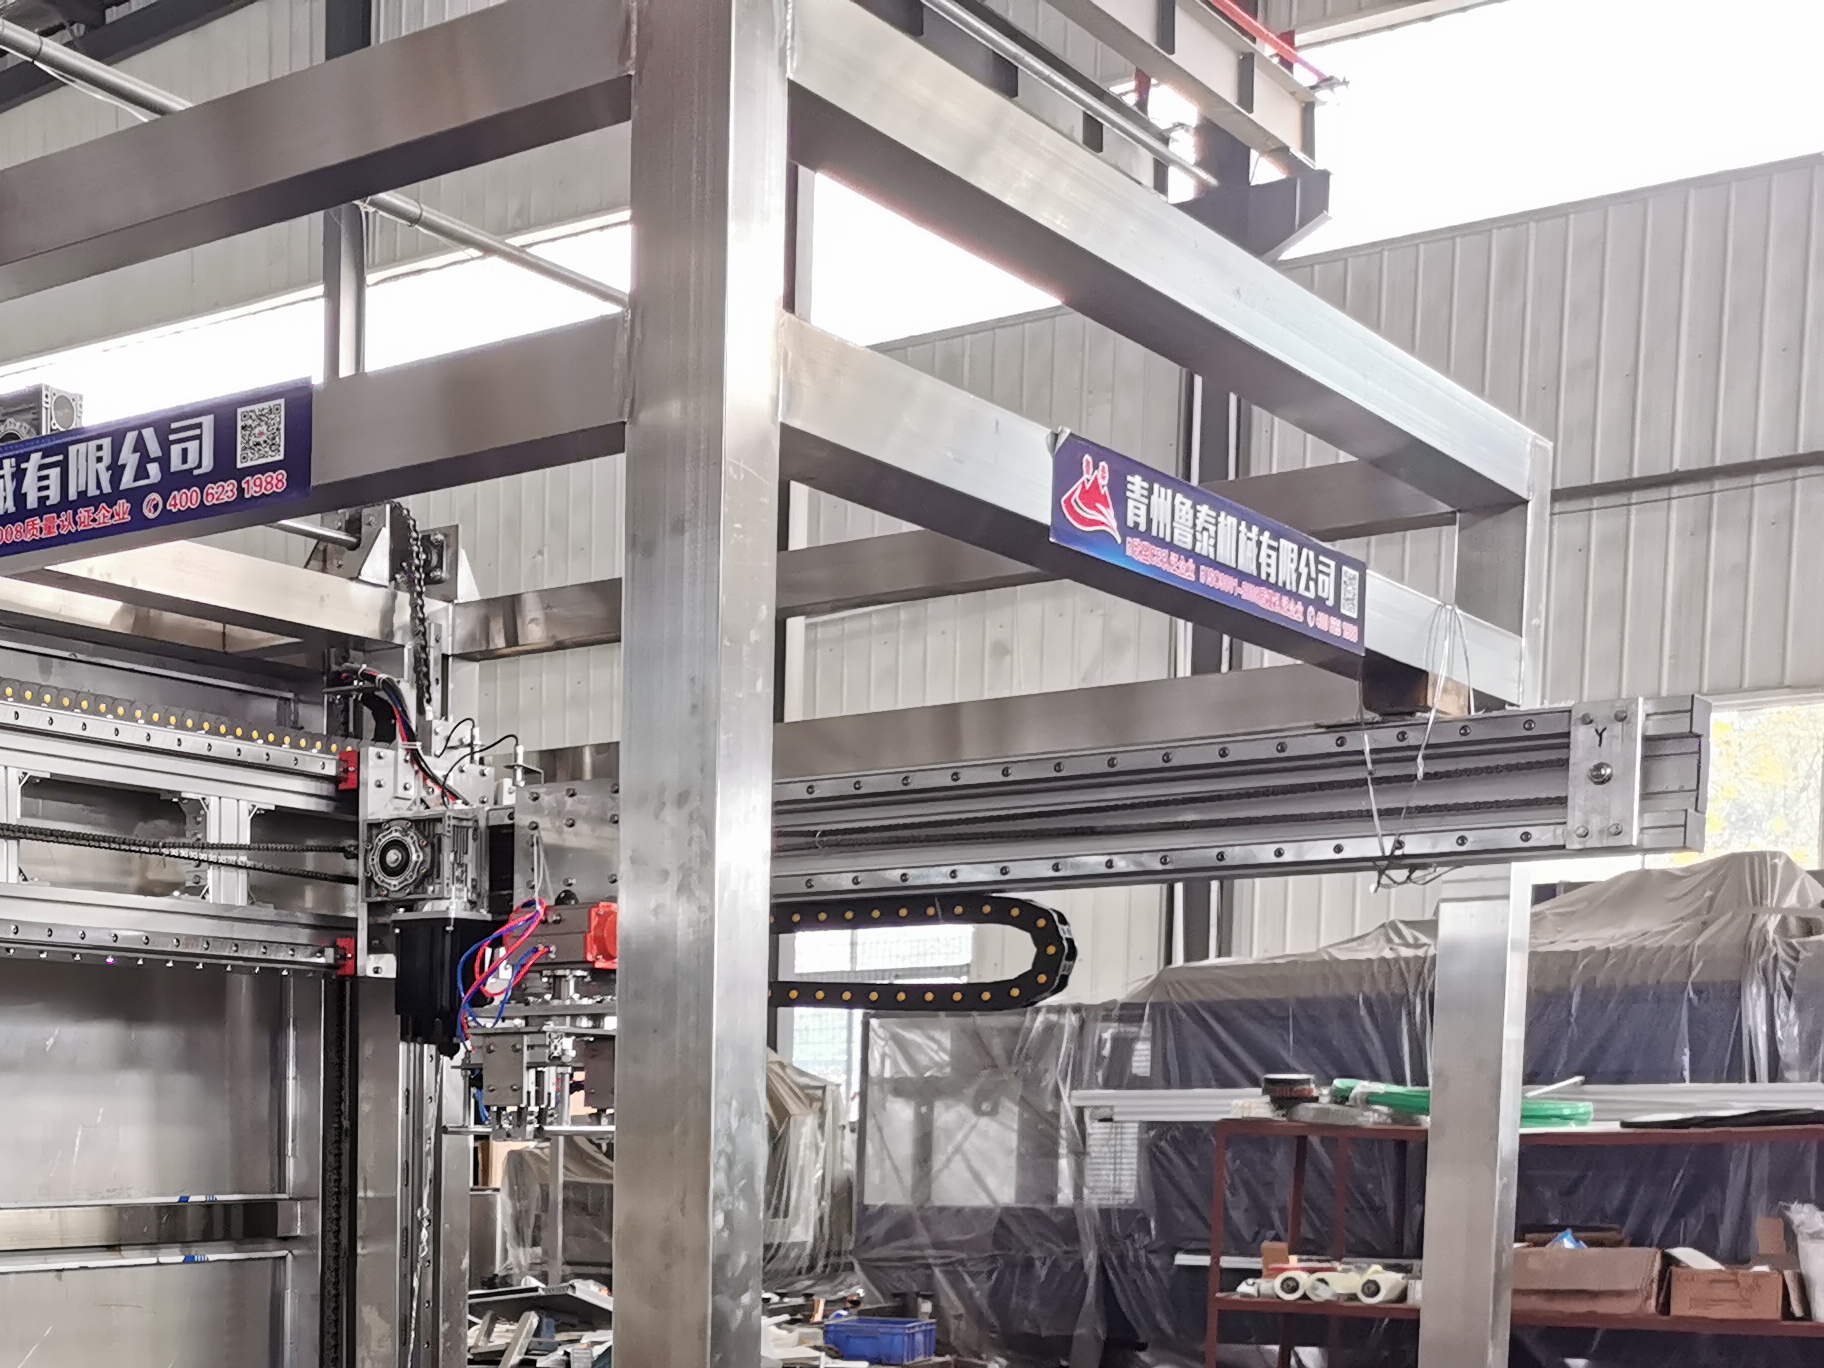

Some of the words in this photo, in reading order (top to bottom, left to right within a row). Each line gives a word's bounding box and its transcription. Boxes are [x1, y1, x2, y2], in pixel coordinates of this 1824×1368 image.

[167, 487, 201, 512] 400
[204, 480, 238, 505] 623
[242, 470, 287, 498] 1988
[1126, 475, 1336, 607] 青州鲁泰机械有限公司
[1594, 726, 1607, 748] Y
